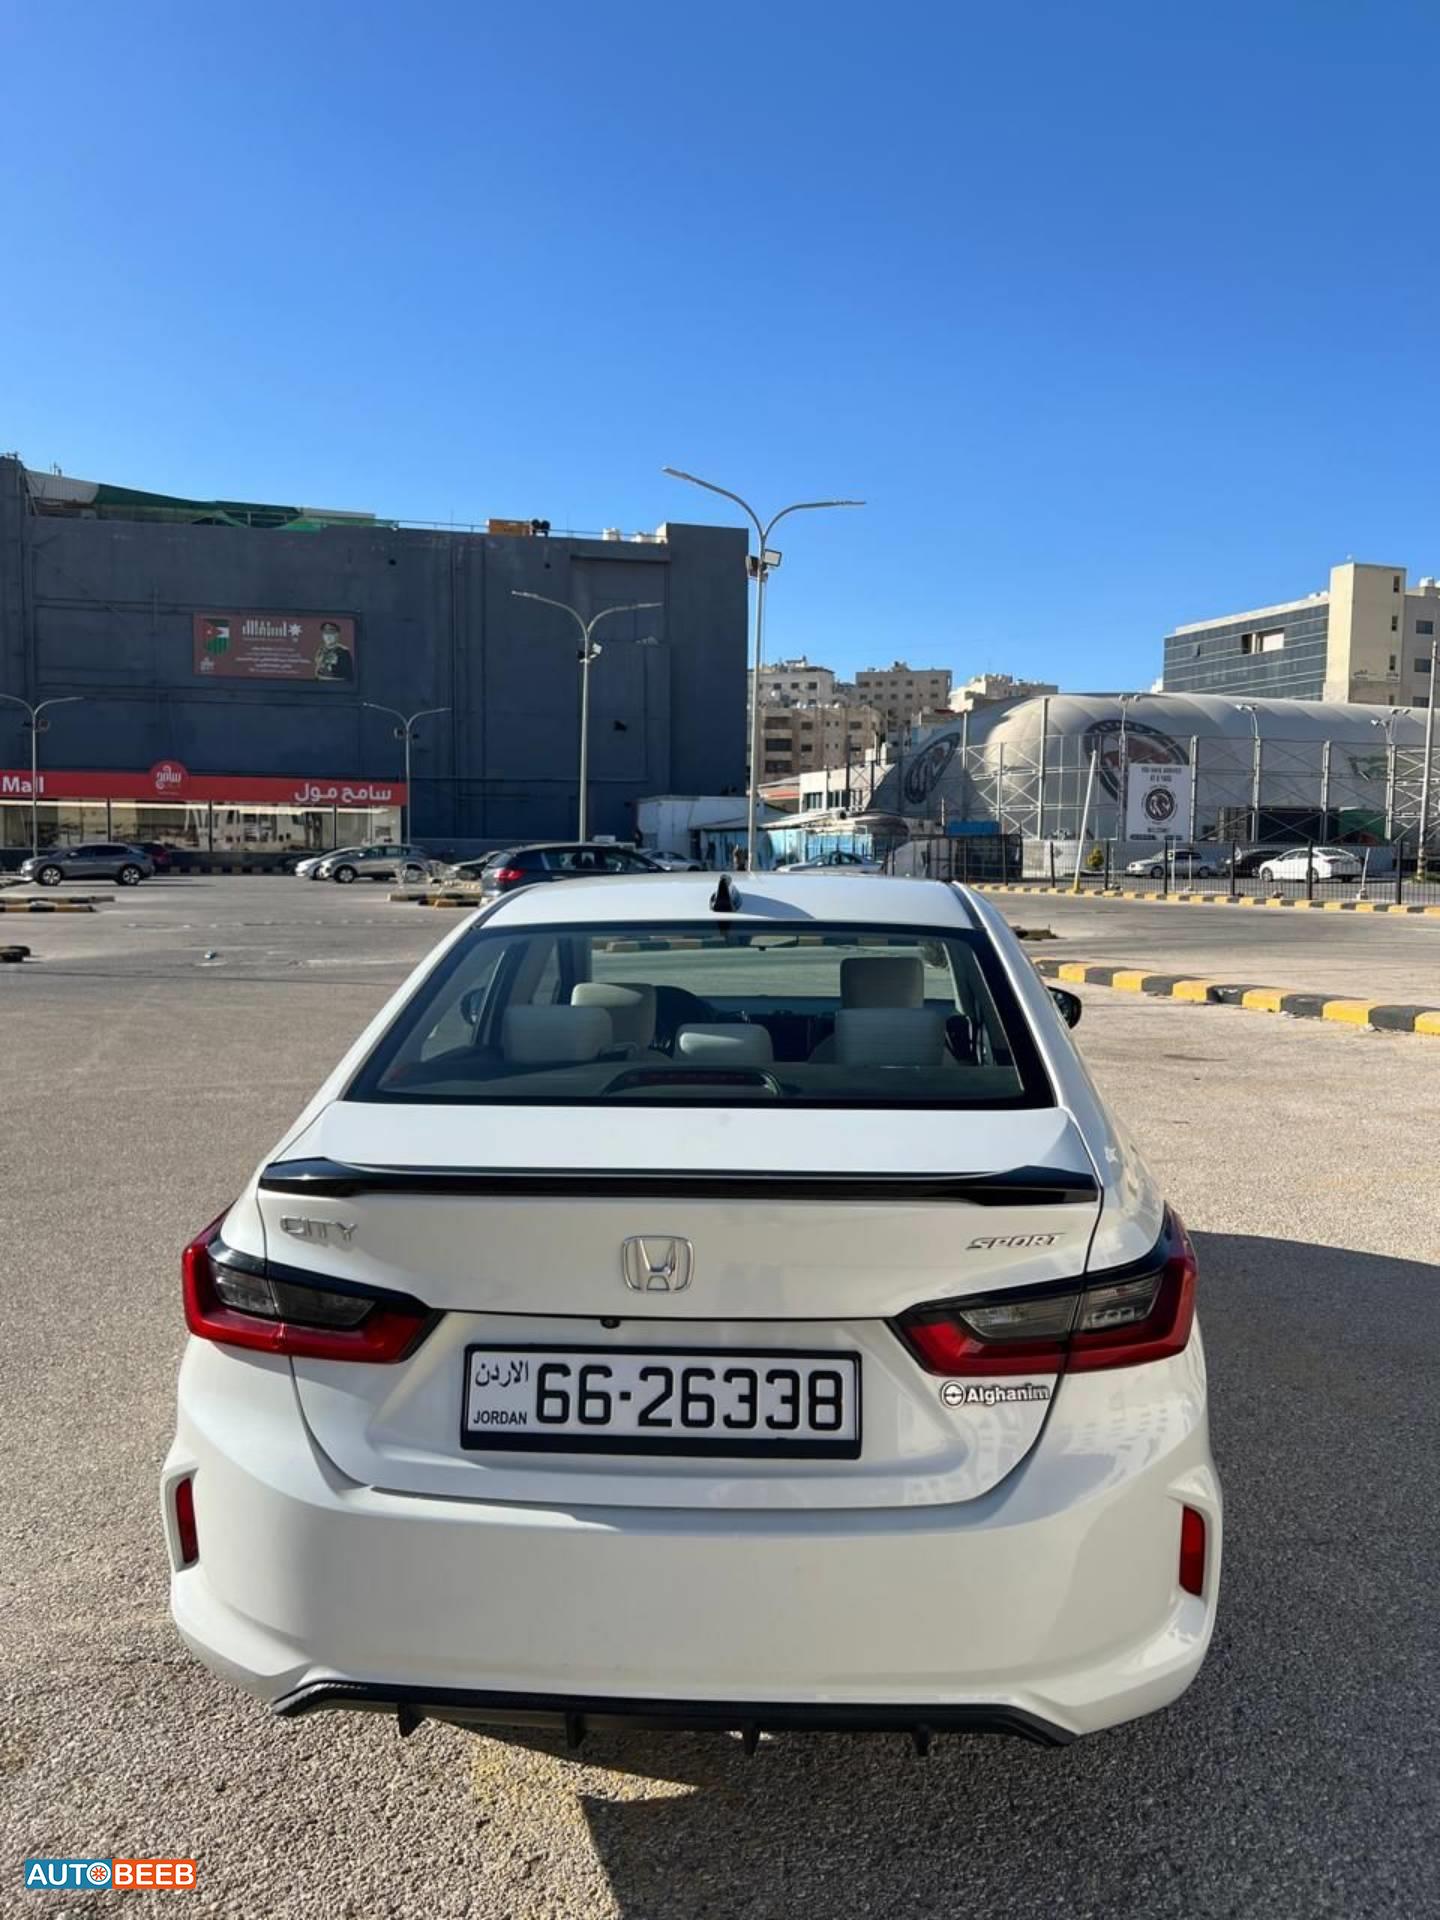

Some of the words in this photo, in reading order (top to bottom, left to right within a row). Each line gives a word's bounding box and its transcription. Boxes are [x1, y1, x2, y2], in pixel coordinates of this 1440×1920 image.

[2, 775, 44, 793] Mall
[294, 783, 337, 802] مول
[342, 784, 392, 803] سامح
[281, 1216, 358, 1242] CITY
[965, 1233, 1065, 1250] SPORT
[967, 1382, 1050, 1405] Alghanim
[473, 1411, 528, 1425] JORDAN
